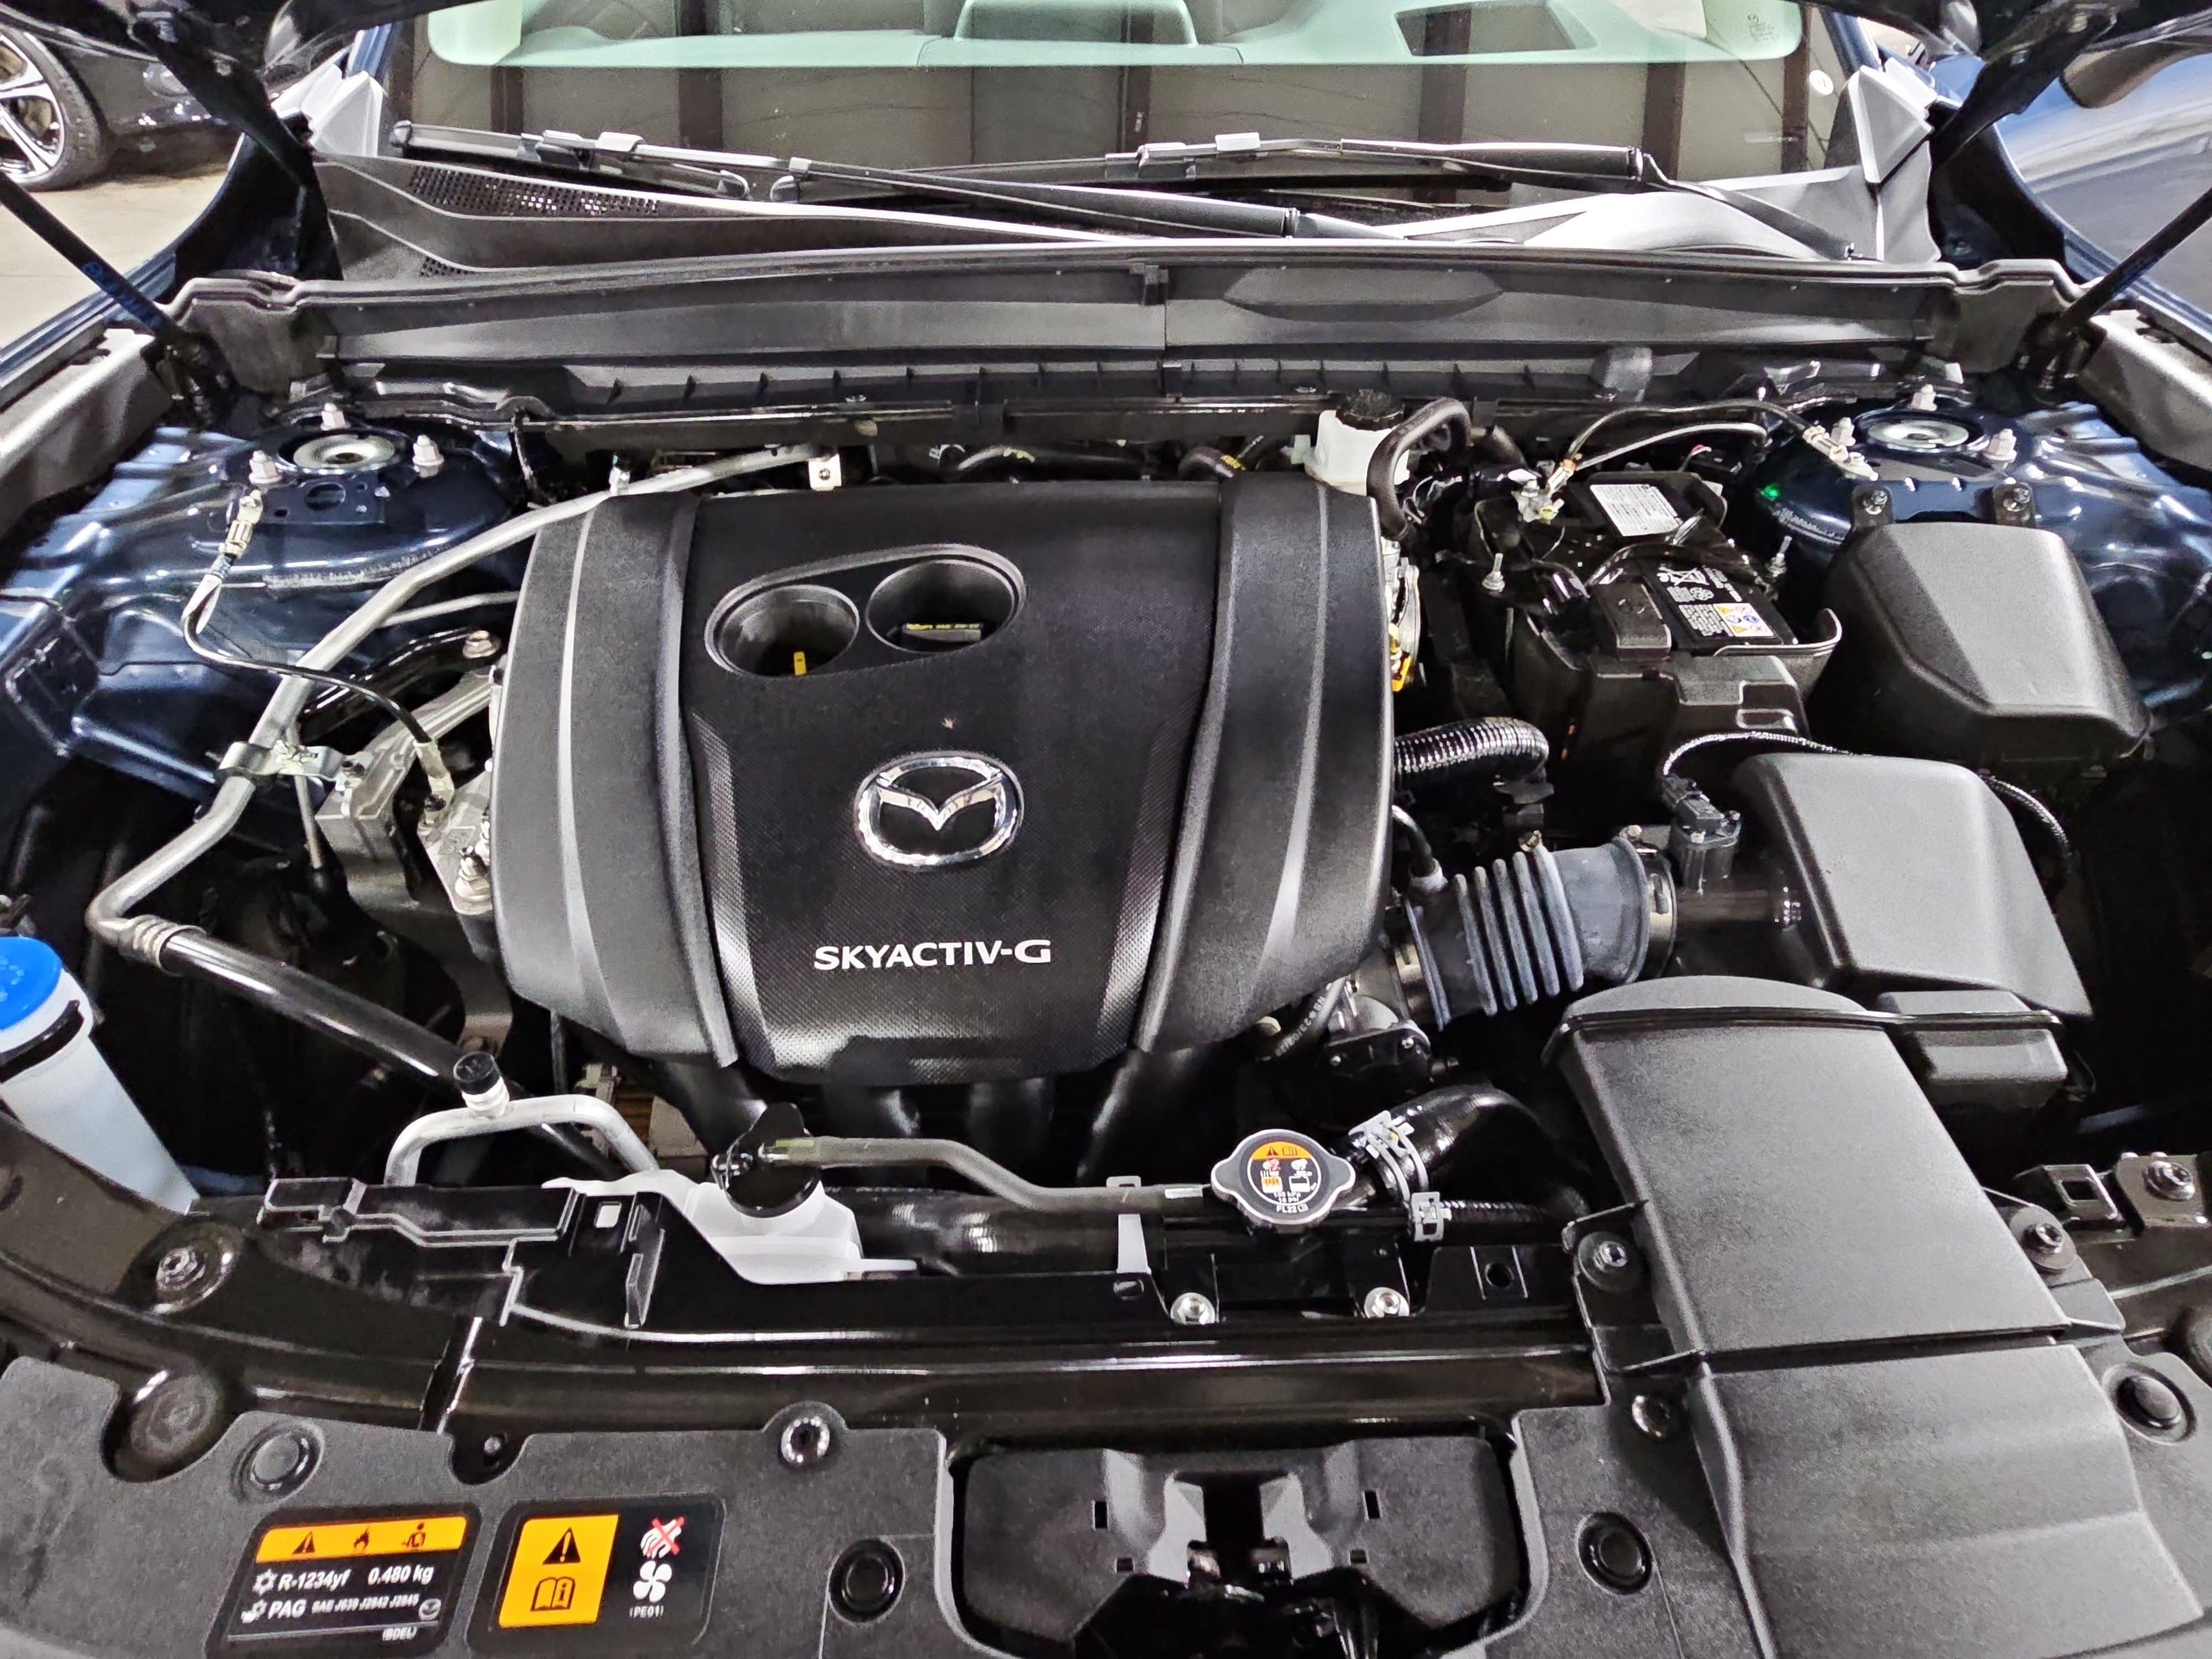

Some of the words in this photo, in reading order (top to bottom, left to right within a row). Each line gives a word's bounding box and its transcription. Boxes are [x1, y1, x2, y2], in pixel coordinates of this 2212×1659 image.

[813, 939, 1051, 971] SKYACTIV-G
[278, 1569, 352, 1592] R-1234yf
[413, 1563, 435, 1585] kg
[268, 1599, 307, 1620] PAG
